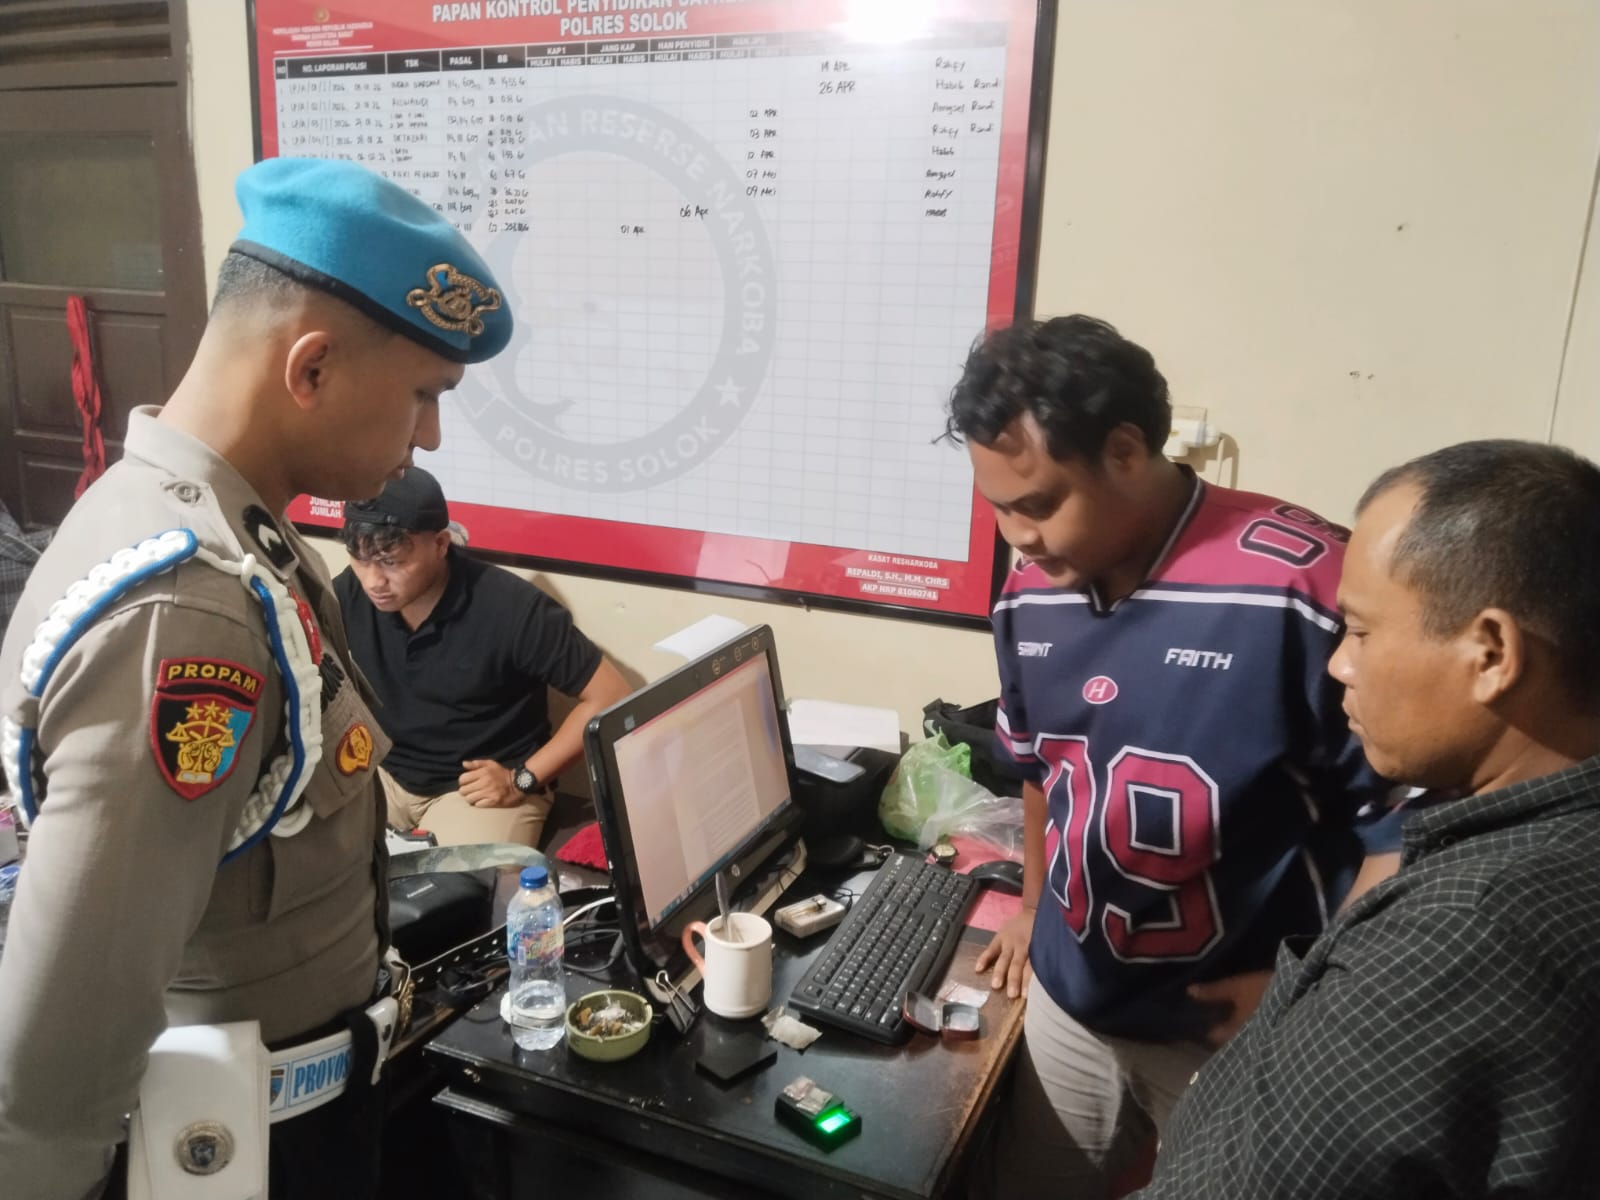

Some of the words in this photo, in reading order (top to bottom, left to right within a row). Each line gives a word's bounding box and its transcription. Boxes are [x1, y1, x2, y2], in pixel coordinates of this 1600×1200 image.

[432, 3, 481, 22] PAPAN
[486, 0, 562, 19] KONTROL
[560, 14, 624, 36] POLRES
[629, 11, 688, 33] SOLOK
[547, 47, 562, 55] KAP
[620, 43, 636, 51] KAP
[658, 41, 673, 50] HAN
[675, 39, 711, 49] PENYIDIK
[314, 63, 345, 72] LAPORAN
[345, 61, 367, 71] POLISI
[405, 59, 419, 67] TSK
[450, 56, 473, 65] PASAL
[819, 81, 833, 95] 26
[746, 185, 758, 198] 09
[580, 108, 709, 182] RESERSE
[706, 178, 766, 357] NARKOBA
[495, 424, 609, 484] POLRES
[619, 416, 721, 483] SOLOK
[310, 506, 341, 519] JUMLAH
[868, 554, 890, 564] KASAT
[862, 583, 878, 592] AKP
[1164, 647, 1234, 671] FAITH
[167, 663, 258, 693] PROPAM
[1088, 681, 1109, 699] H
